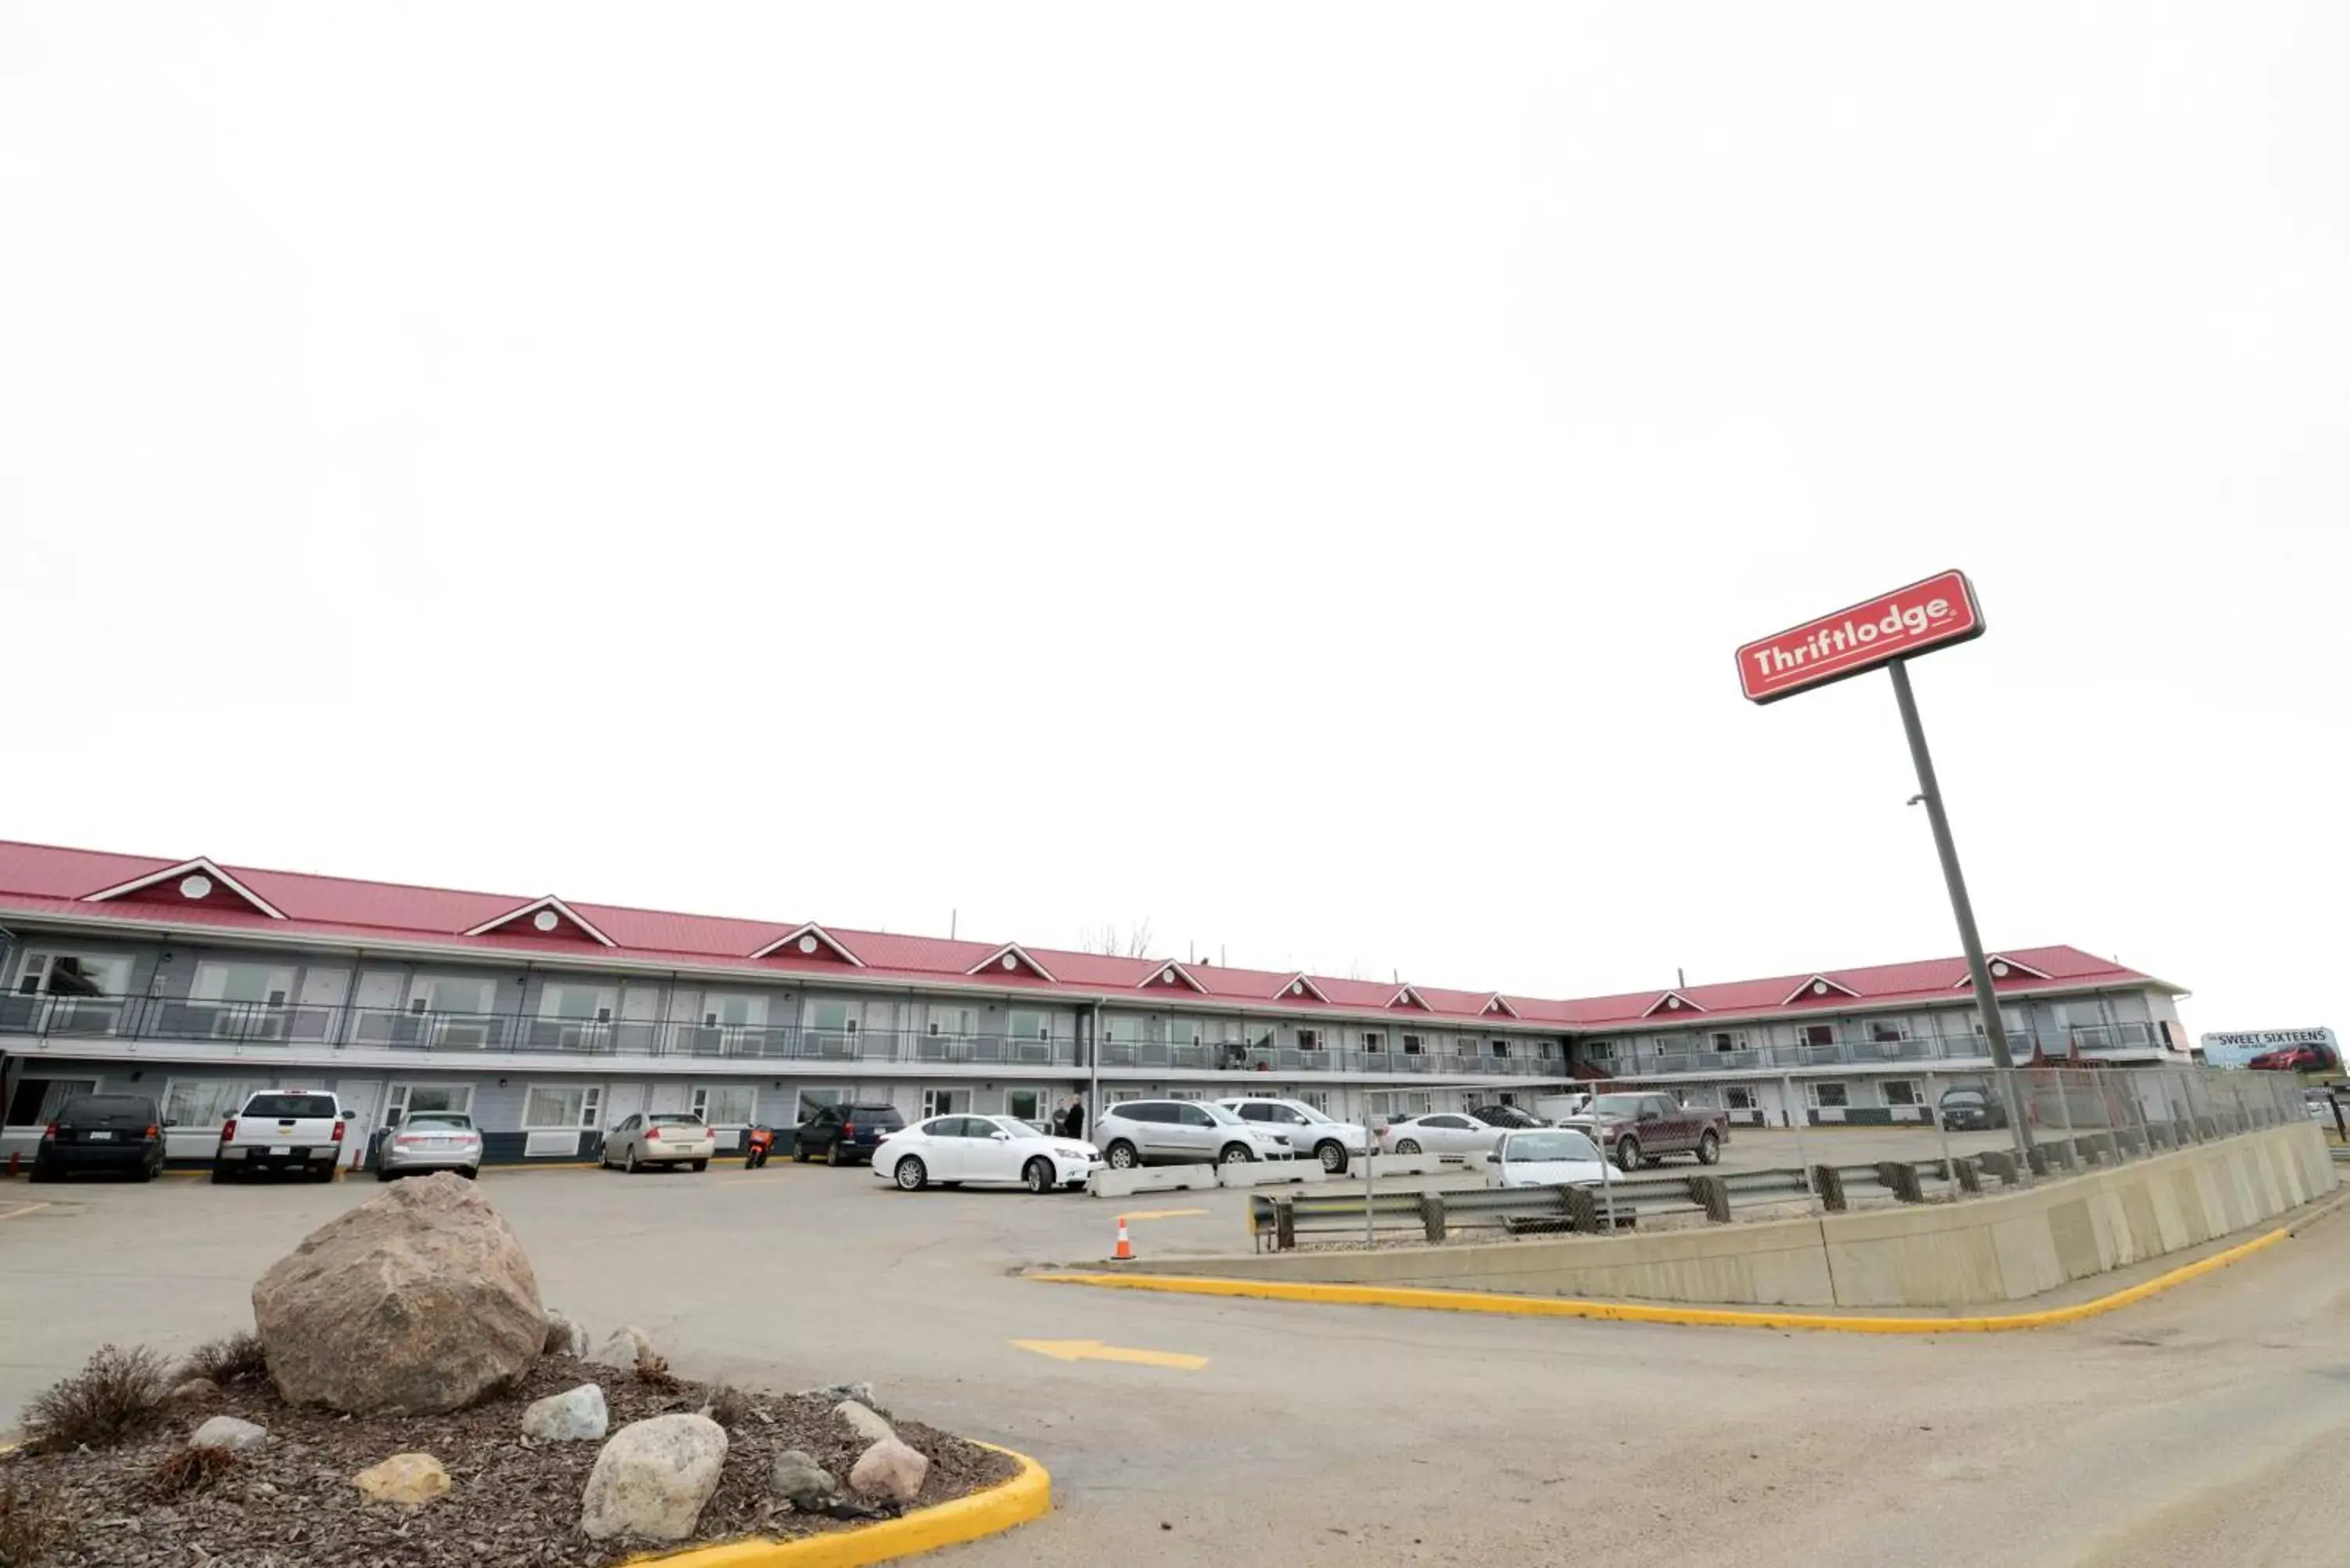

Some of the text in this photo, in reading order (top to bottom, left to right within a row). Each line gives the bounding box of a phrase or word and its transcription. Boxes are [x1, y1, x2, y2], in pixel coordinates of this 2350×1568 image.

[1754, 598, 1948, 676] Thriftlodge
[2218, 1034, 2260, 1046] SWEET
[2264, 1030, 2326, 1043] SIXTEENS
